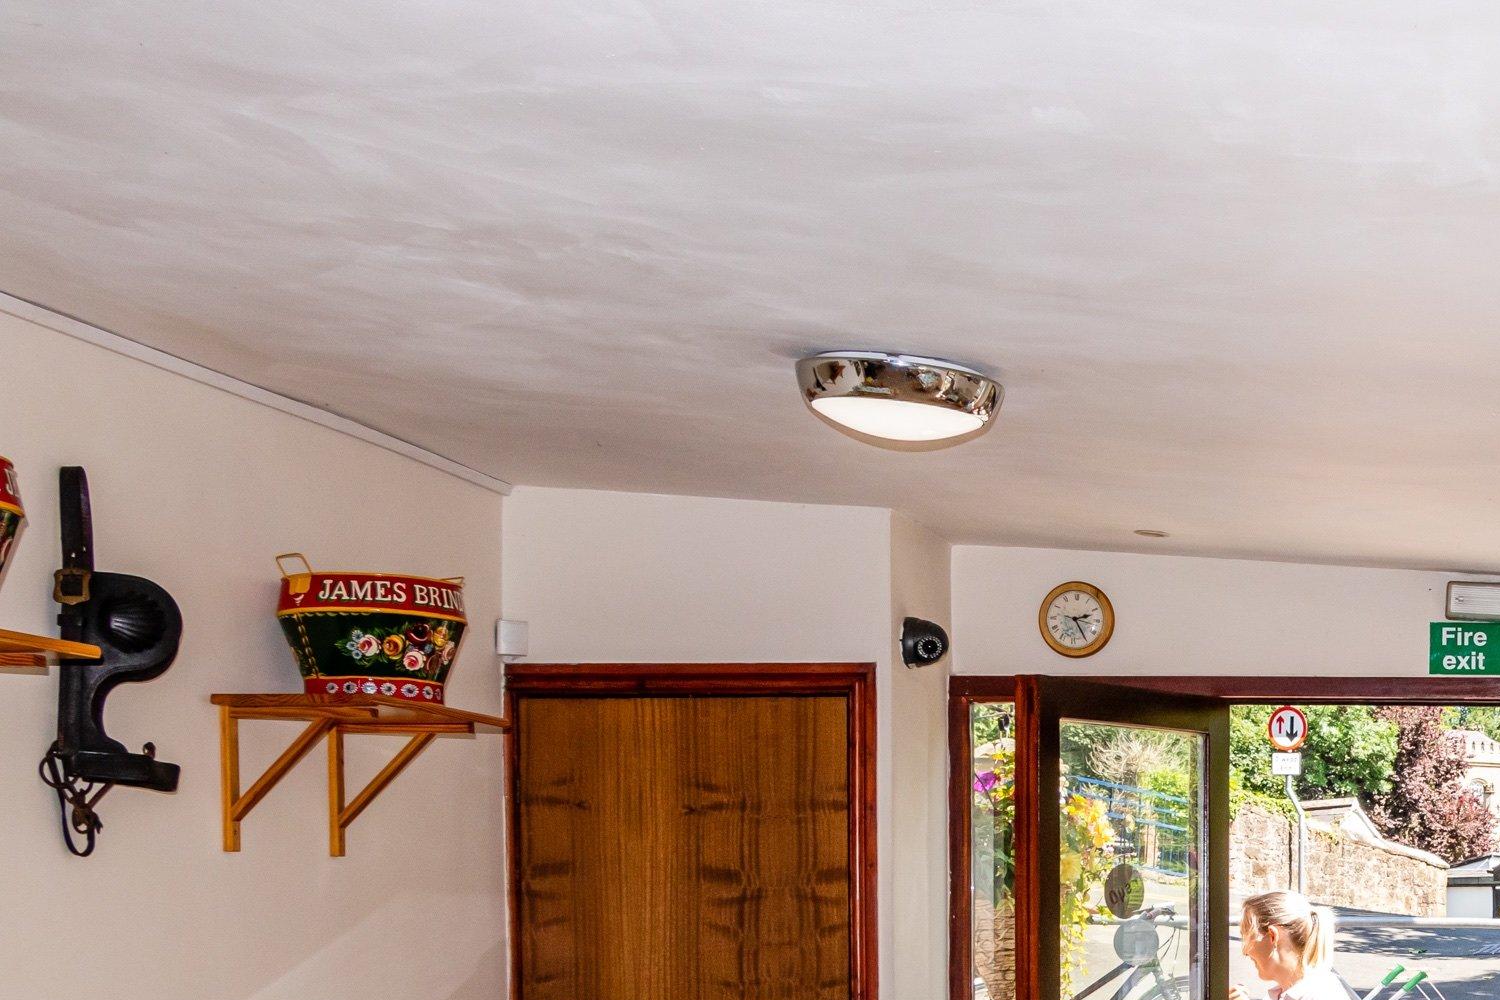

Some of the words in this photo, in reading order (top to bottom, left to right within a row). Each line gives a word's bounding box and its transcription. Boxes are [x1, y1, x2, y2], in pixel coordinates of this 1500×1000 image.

[319, 579, 407, 603] JAMES
[1442, 627, 1488, 646] Fire
[1442, 651, 1486, 670] exit
